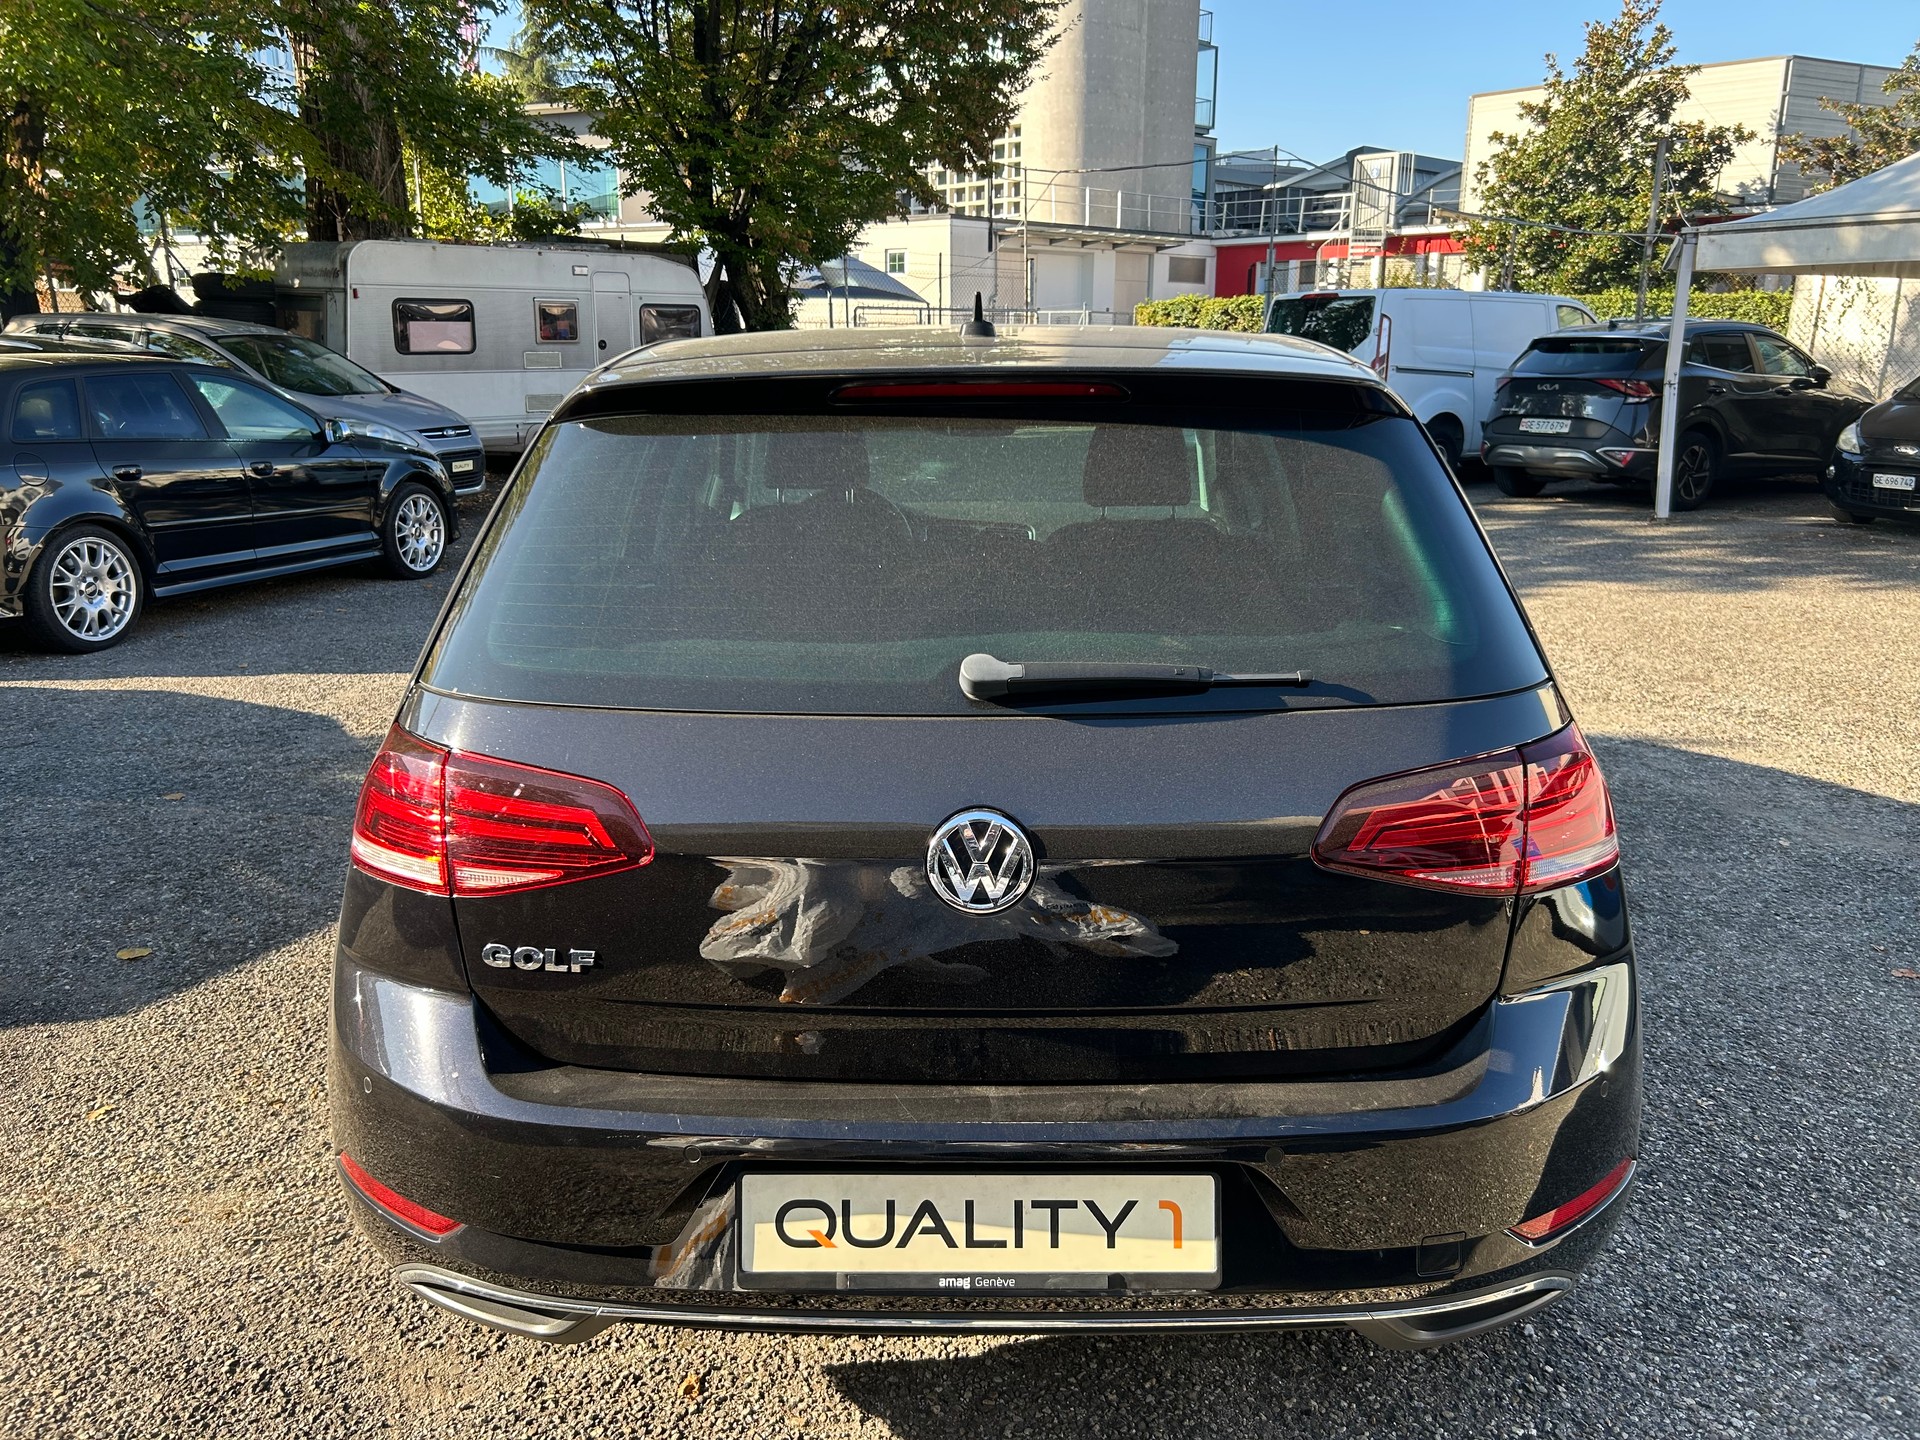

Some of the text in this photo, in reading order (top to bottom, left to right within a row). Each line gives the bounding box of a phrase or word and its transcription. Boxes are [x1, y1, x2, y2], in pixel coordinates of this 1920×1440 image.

[1874, 476, 1884, 484] GE
[939, 819, 1022, 906] VW
[481, 943, 596, 973] GOLF
[774, 1198, 1183, 1250] QUALITY 1
[938, 1276, 1016, 1290] amag Genève
